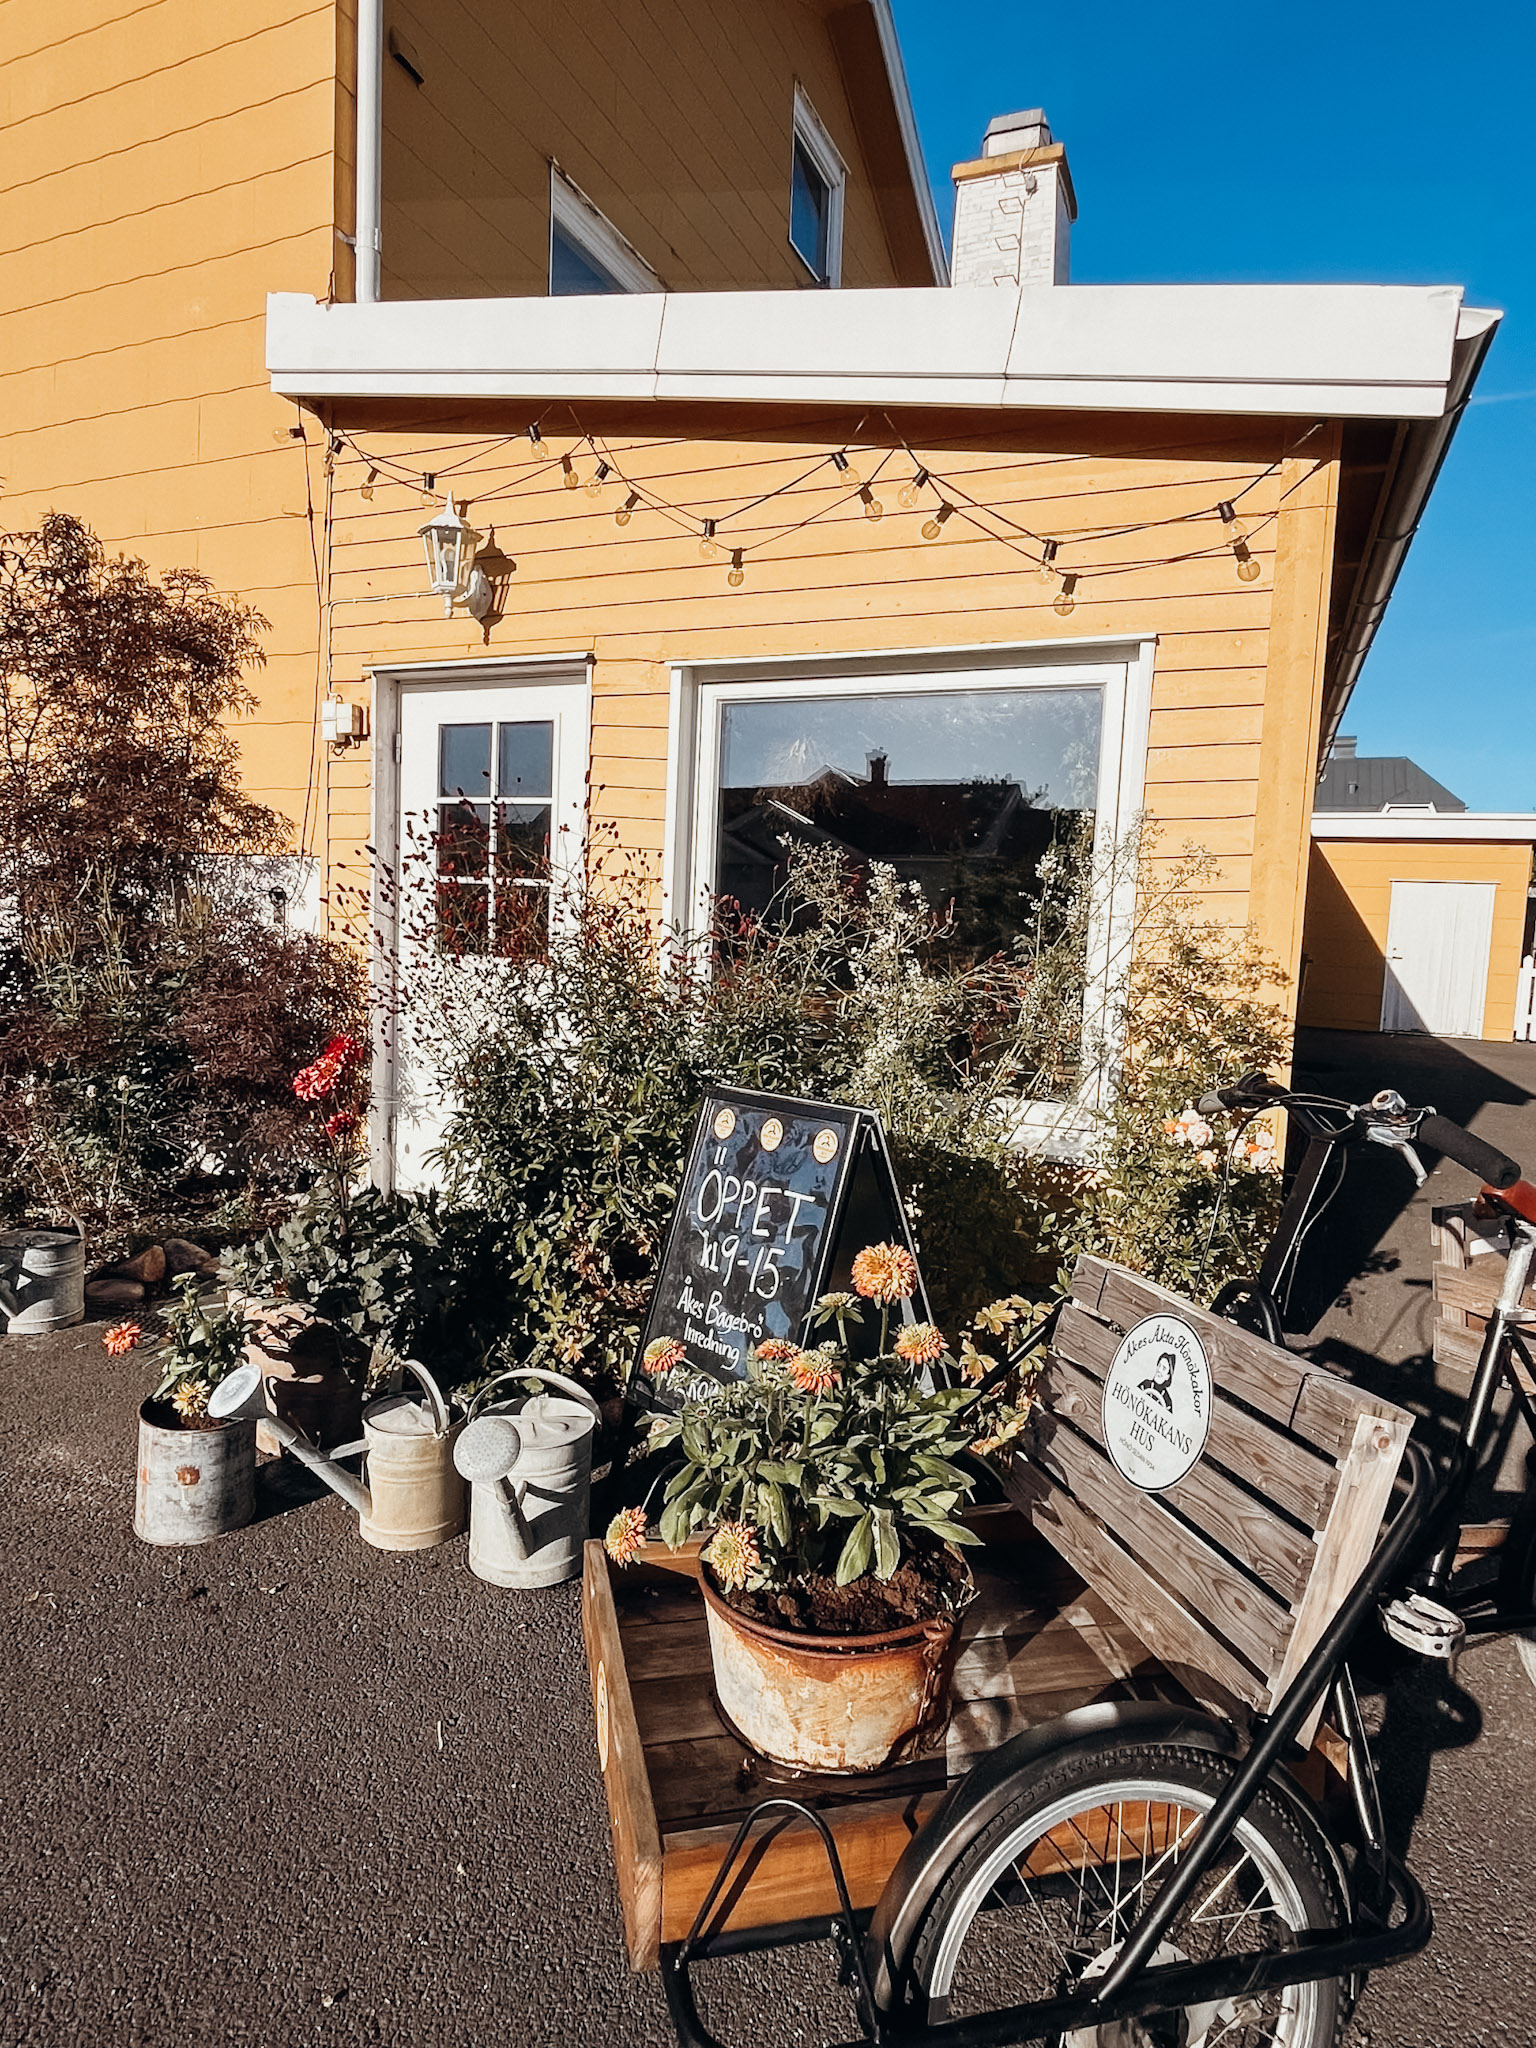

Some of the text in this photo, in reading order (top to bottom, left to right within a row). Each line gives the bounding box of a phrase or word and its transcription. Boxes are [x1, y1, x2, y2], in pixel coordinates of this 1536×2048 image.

[697, 1146, 815, 1244] ÖPPET
[676, 1275, 704, 1319] Åkes
[721, 1234, 786, 1299] 9-15
[683, 1317, 740, 1371] Inredning
[1174, 1335, 1203, 1418] Hönökakor
[1111, 1381, 1193, 1455] HÖNÖKAKANS
[1129, 1421, 1156, 1452] HUS
